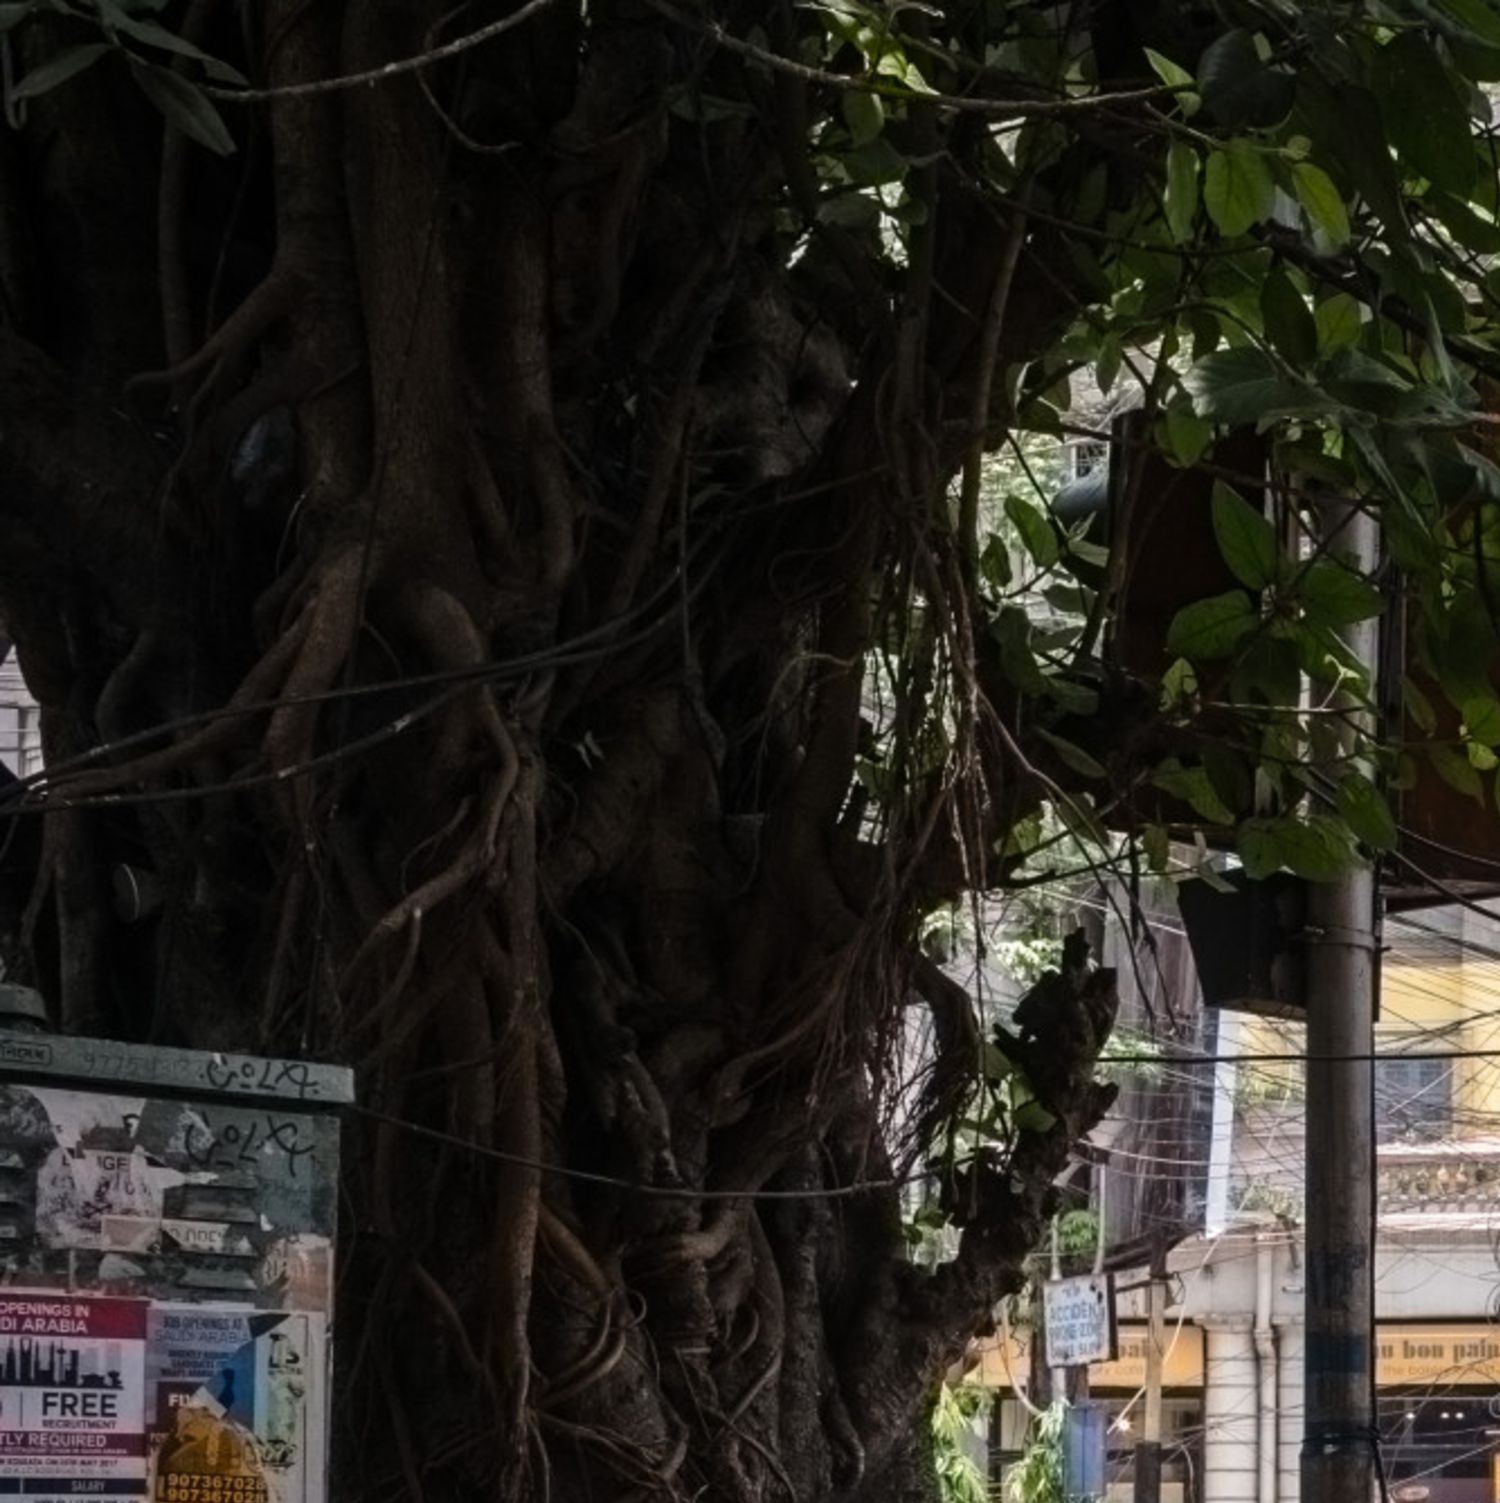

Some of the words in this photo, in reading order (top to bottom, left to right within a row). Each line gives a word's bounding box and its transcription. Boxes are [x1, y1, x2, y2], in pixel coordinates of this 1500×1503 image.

[74, 1305, 90, 1318] IN
[2, 1316, 17, 1331] DI
[22, 1317, 88, 1334] ARABIA
[1403, 1339, 1444, 1359] bon
[1452, 1338, 1500, 1364] pain
[42, 1391, 118, 1417] FREE
[42, 1420, 117, 1430] RECRUITMENT
[0, 1431, 25, 1446] TLY
[28, 1433, 107, 1448] REQUIRED
